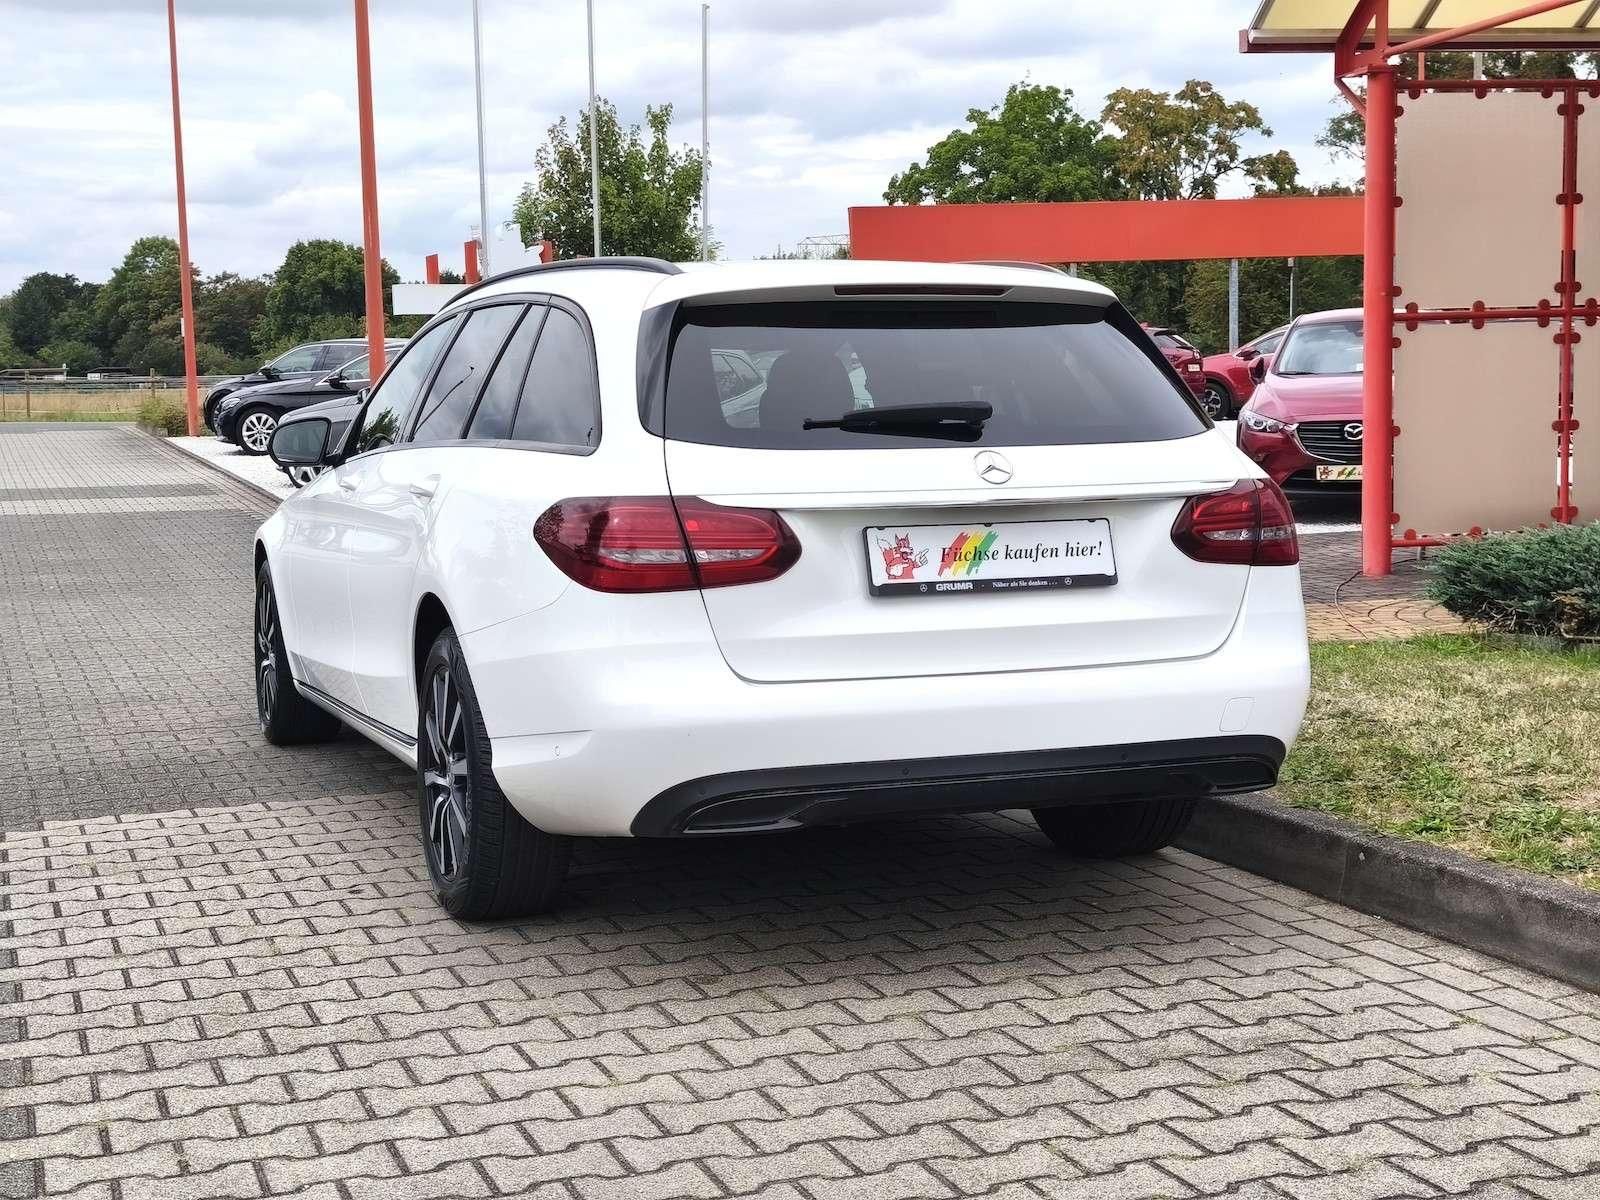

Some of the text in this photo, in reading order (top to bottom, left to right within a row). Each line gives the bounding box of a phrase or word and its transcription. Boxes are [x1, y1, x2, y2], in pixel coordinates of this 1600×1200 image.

[940, 541, 1102, 563] Füchse kaufen hier!
